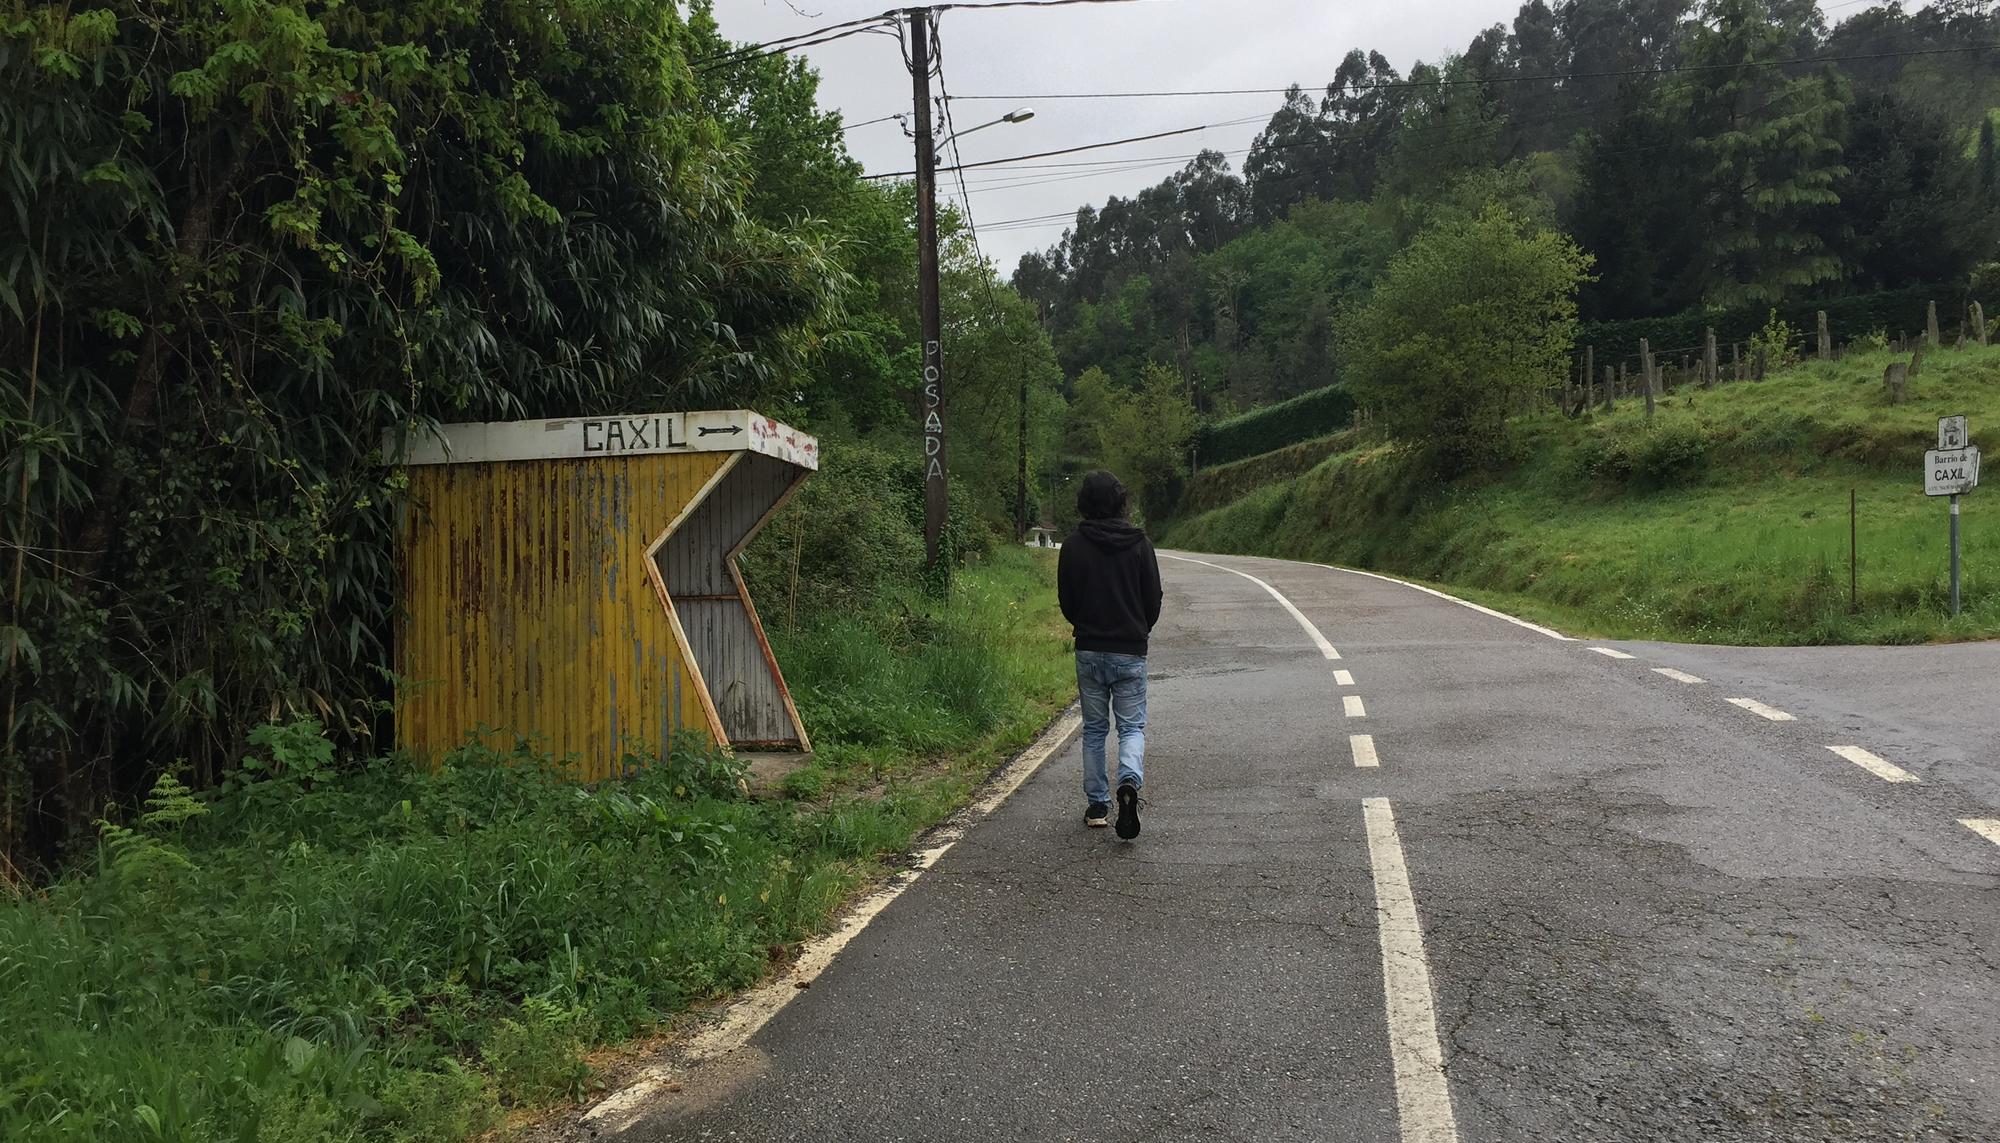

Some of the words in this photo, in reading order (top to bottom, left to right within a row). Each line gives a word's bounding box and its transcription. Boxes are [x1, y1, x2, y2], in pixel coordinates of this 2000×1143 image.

[924, 340, 944, 481] POSADA
[583, 418, 687, 451] CAXIL
[1934, 454, 1958, 464] Barrio
[1934, 468, 1966, 481] CAXIL
